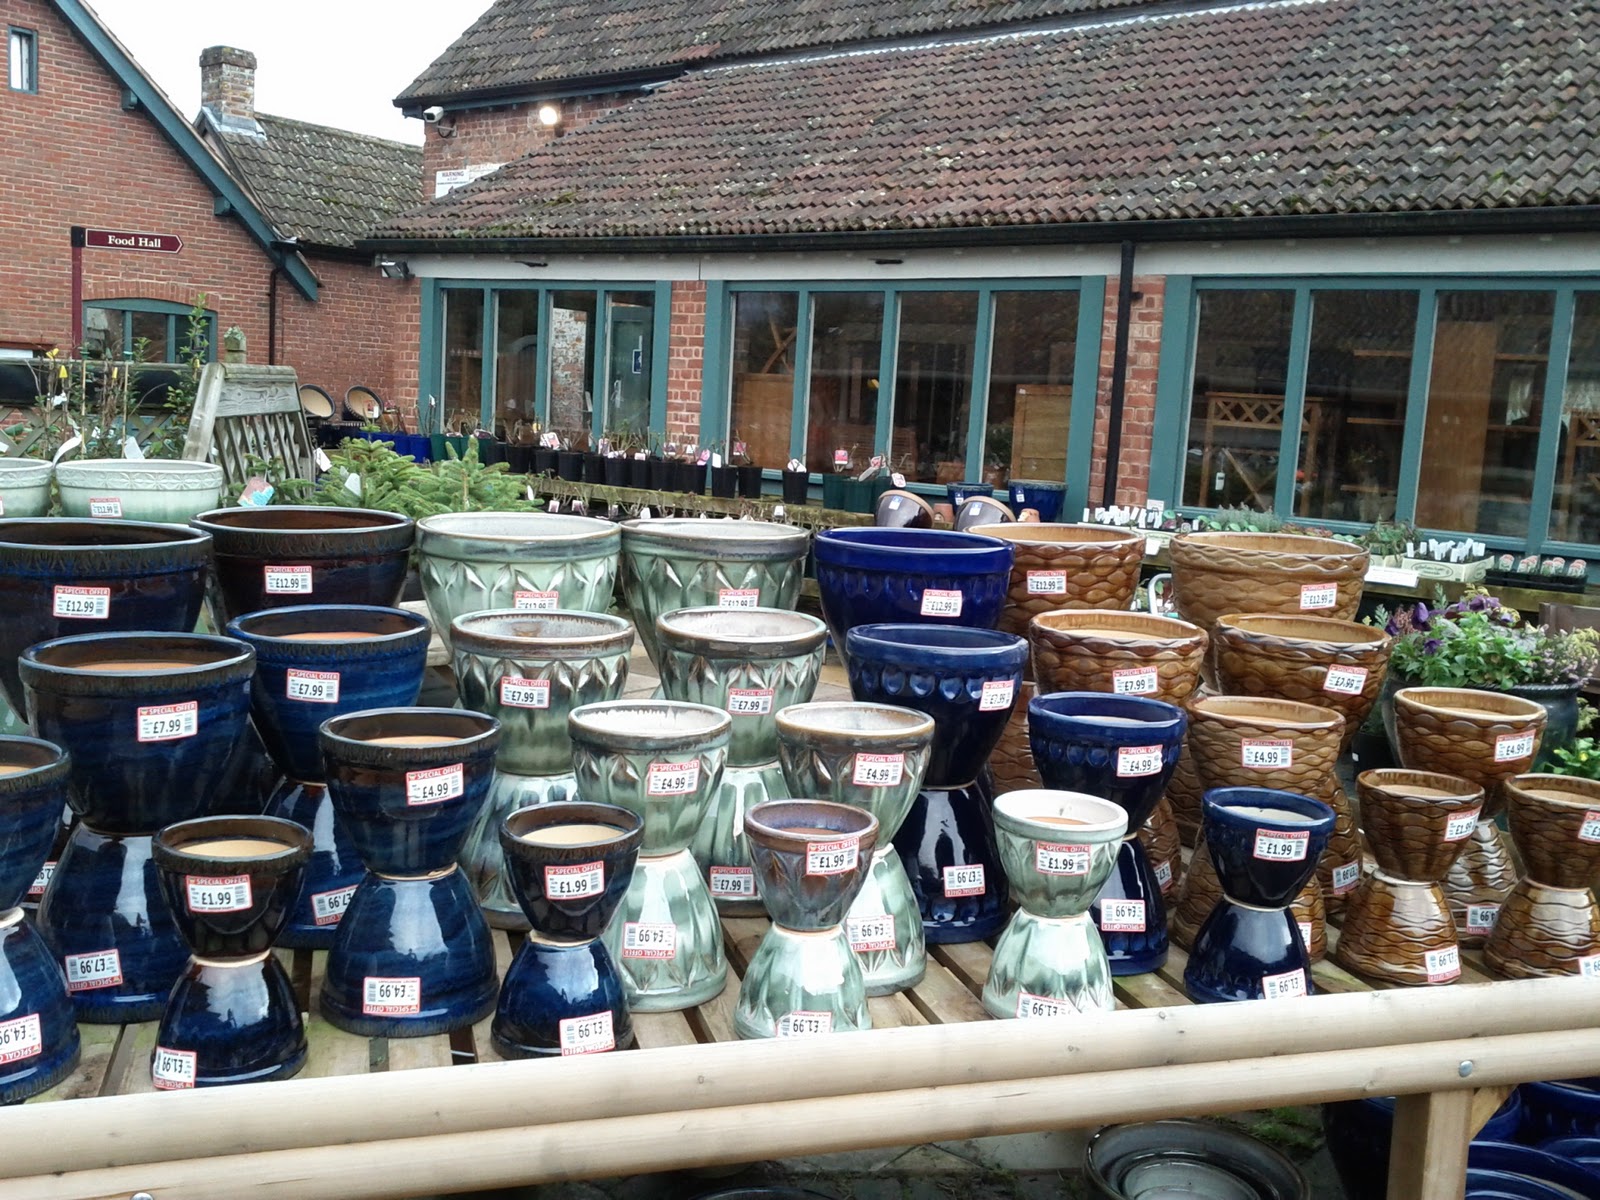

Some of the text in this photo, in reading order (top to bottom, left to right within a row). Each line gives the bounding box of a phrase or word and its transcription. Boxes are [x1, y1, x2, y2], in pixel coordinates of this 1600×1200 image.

[108, 235, 161, 248] Food Hall
[276, 578, 300, 588] £12.99
[1036, 581, 1056, 590] £12.99
[1309, 594, 1328, 604] £12.99
[66, 600, 94, 612] £12.99
[931, 602, 952, 611] £12.99
[1124, 680, 1146, 691] £7.99
[1334, 676, 1354, 688] £7.99
[298, 684, 324, 696] £7.99
[511, 690, 534, 702] £7.99
[150, 703, 196, 715] SPECIAL OFFER
[738, 700, 760, 710] £7.99
[154, 719, 181, 734] £7.99
[1506, 743, 1525, 756] £4.99
[1254, 752, 1278, 763] £4.99
[660, 764, 680, 772] SPECIAL
[1130, 760, 1152, 772] £4.99
[418, 766, 461, 780] SPECIAL OFFER
[866, 768, 890, 780] £4.99
[661, 777, 686, 790] £4.99
[422, 782, 448, 798] £4.99
[841, 840, 858, 848] OFFER
[1266, 843, 1292, 856] £1.99
[820, 854, 844, 868] £1.99
[1048, 858, 1074, 870] £1.99
[582, 863, 601, 872] OFFER
[226, 876, 248, 884] OFFER
[957, 871, 976, 884] £7.99
[560, 879, 587, 894] £1.99
[720, 880, 742, 890] £7.99
[202, 892, 232, 905] £1.99
[1115, 906, 1136, 918] £4.99
[638, 929, 664, 942] £4.99
[862, 923, 884, 937] £4.99
[80, 958, 105, 974] £7.99
[90, 978, 113, 986] SPECIAL
[1280, 978, 1298, 993] £1.99
[379, 984, 406, 998] £4.99
[1032, 1002, 1058, 1016] £1.99
[578, 1021, 602, 1038] £1.99
[793, 1019, 819, 1033] £1.99
[8, 1048, 32, 1058] SPECIAL
[162, 1057, 183, 1074] £1.99
